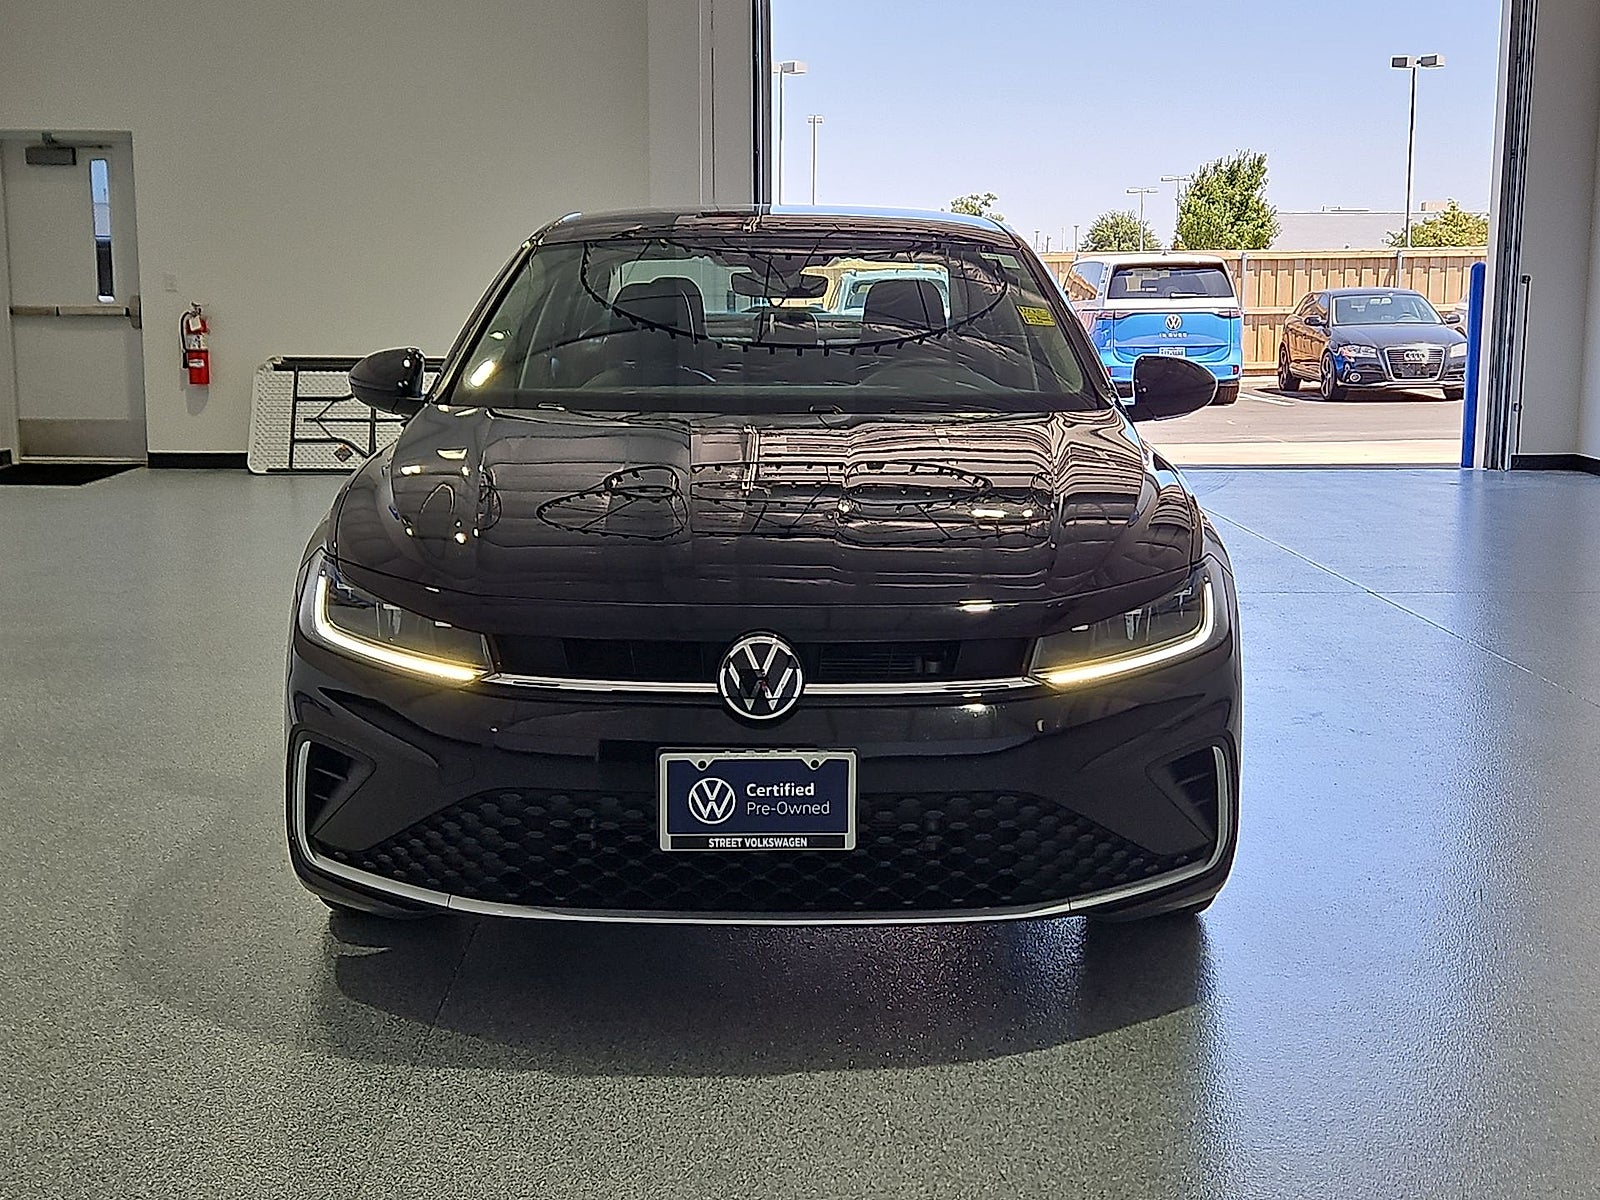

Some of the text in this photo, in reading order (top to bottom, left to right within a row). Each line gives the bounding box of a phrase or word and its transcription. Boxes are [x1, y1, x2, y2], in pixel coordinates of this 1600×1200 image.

[746, 783, 815, 797] Certified
[747, 801, 830, 815] Pre-Owned
[708, 837, 807, 848] STREET VOLKSWAGEN
